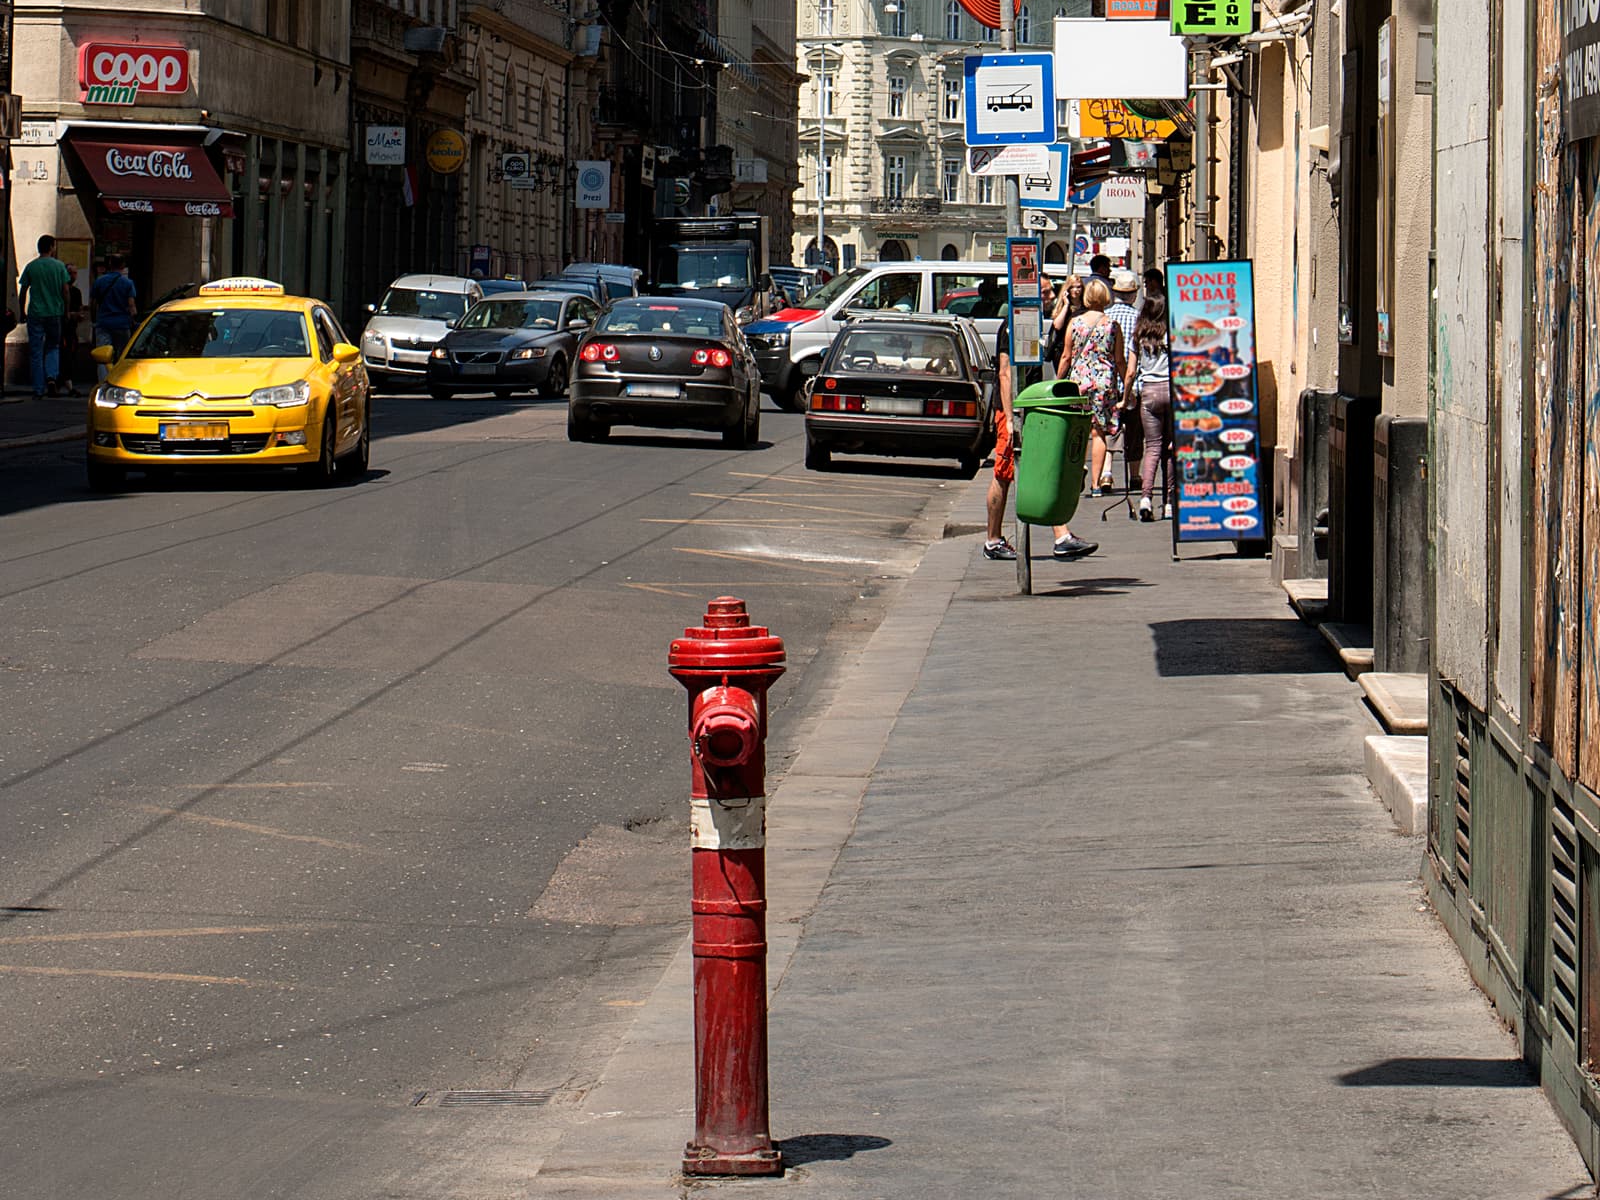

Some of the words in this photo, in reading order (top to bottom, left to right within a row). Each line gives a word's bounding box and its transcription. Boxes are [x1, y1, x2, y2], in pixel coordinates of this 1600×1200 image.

[1111, 0, 1141, 11] IRODA
[93, 51, 182, 92] coop
[87, 80, 139, 104] mini
[105, 148, 192, 179] Coca-Cola
[583, 193, 602, 202] Prezi
[1106, 188, 1136, 198] IRODA
[1176, 270, 1237, 288] DÖNER
[1179, 287, 1237, 302] KEBAB
